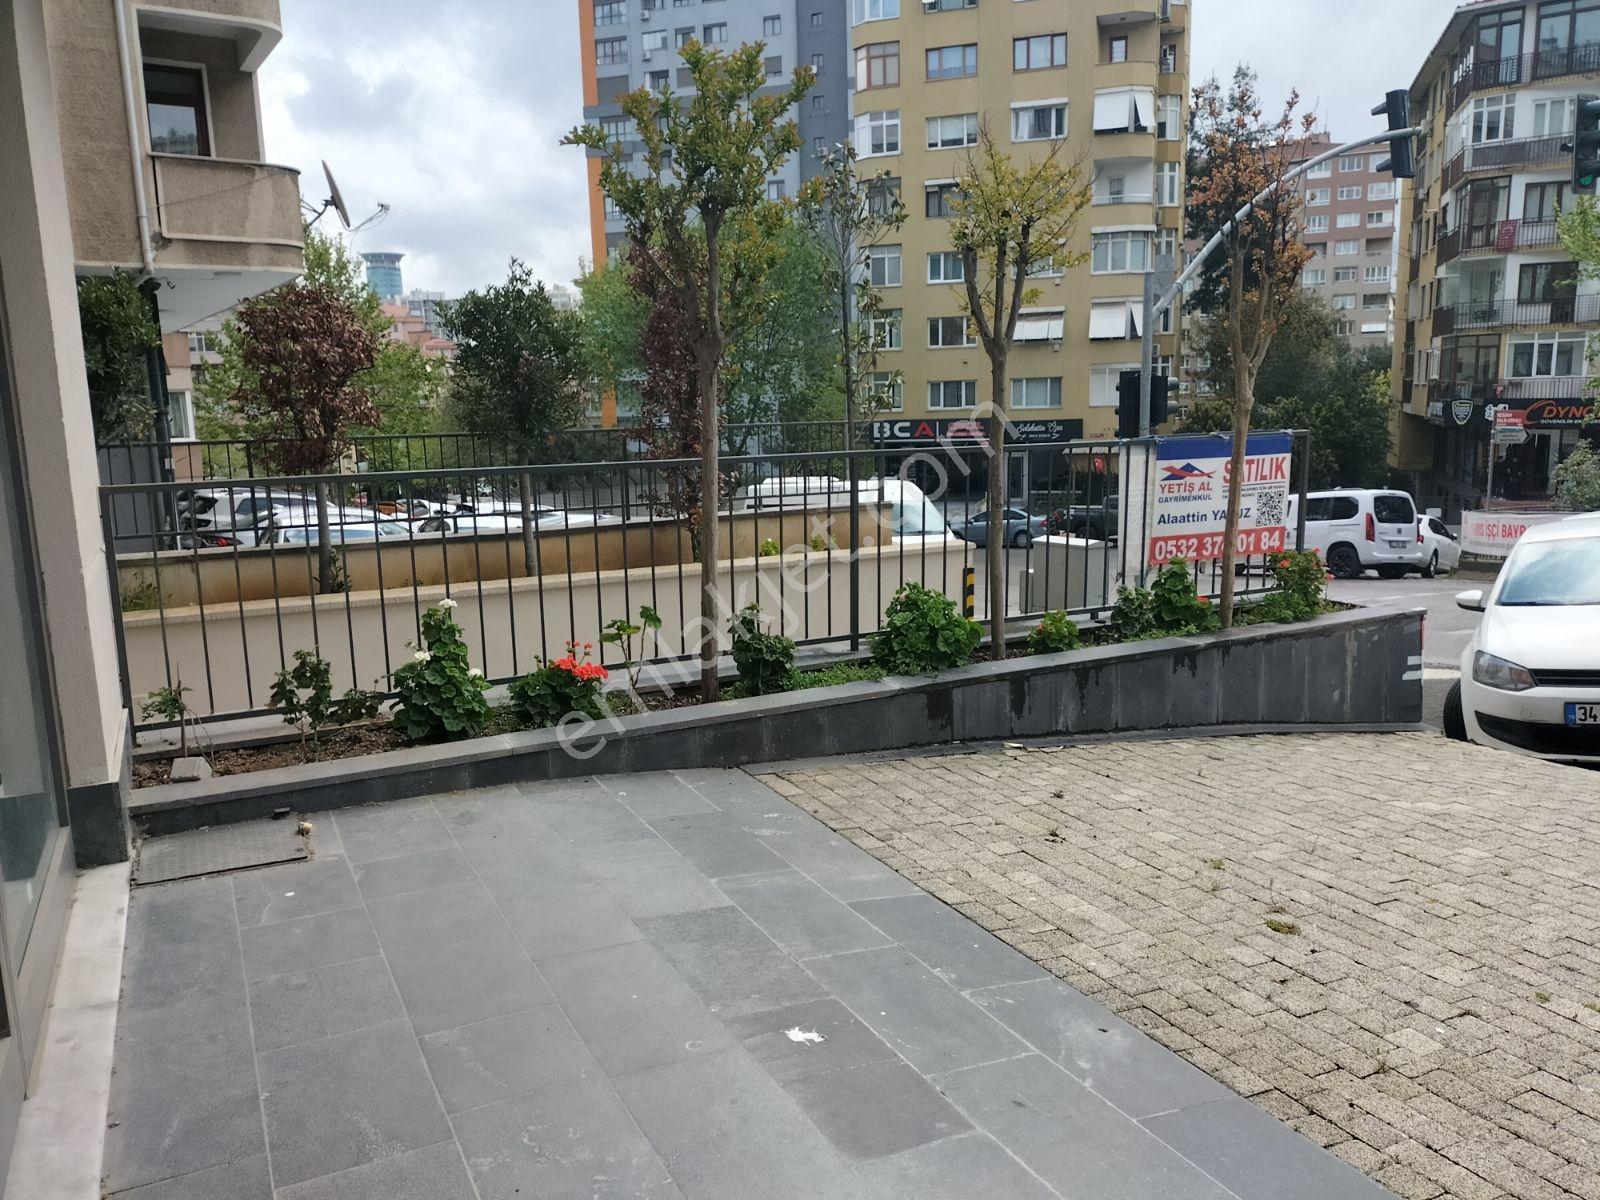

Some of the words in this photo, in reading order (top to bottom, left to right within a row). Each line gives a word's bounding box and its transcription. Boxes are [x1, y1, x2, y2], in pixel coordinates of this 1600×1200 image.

[873, 421, 934, 438] BCA
[1222, 456, 1287, 484] STILIK
[1160, 482, 1196, 495] YETİŞ
[1198, 481, 1213, 492] AL
[1158, 494, 1213, 504] GAYRİMENKUL
[1157, 511, 1207, 526] Alaattin
[1212, 508, 1252, 520] YAUZ
[1155, 538, 1199, 560] 0532
[1203, 535, 1225, 558] 37
[1237, 533, 1256, 552] 01
[1260, 530, 1281, 549] 84
[1578, 706, 1598, 722] 34
